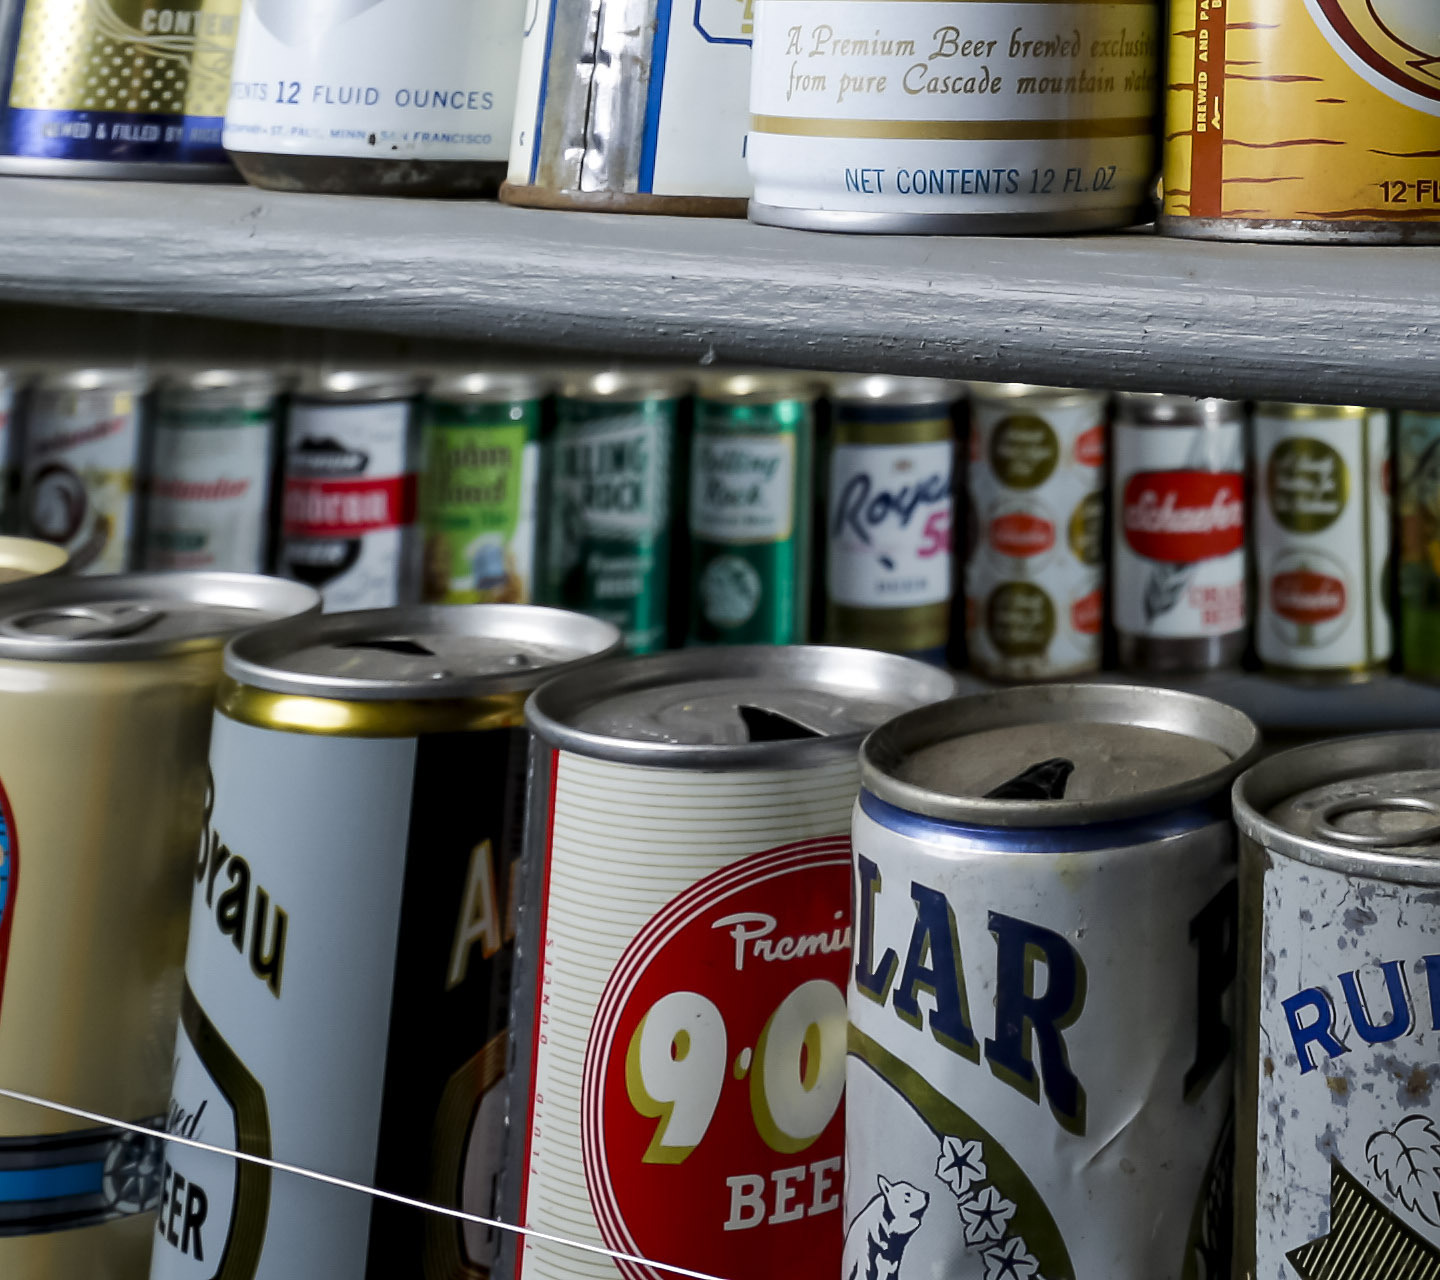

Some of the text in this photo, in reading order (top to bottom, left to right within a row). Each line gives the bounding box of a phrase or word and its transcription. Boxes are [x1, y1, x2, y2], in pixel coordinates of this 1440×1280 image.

[785, 25, 803, 56] A
[809, 24, 915, 58] Premium
[928, 26, 997, 61] Beer
[1008, 26, 1081, 59] brewed
[1199, 28, 1208, 62] AND
[275, 80, 494, 111] 12 FLUID OUNCES
[785, 60, 827, 102] from
[837, 75, 887, 104] pure
[902, 63, 1002, 96] Cascade
[1016, 72, 1115, 96] mountain
[1197, 70, 1208, 132] BREWED
[412, 131, 492, 145] FRANCISCO
[844, 167, 885, 194] NET
[896, 167, 1020, 194] CONTENTS
[1029, 167, 1055, 194] 12
[1379, 180, 1407, 204] 12
[723, 1155, 843, 1231] BEE
[157, 1165, 209, 1263] EER
